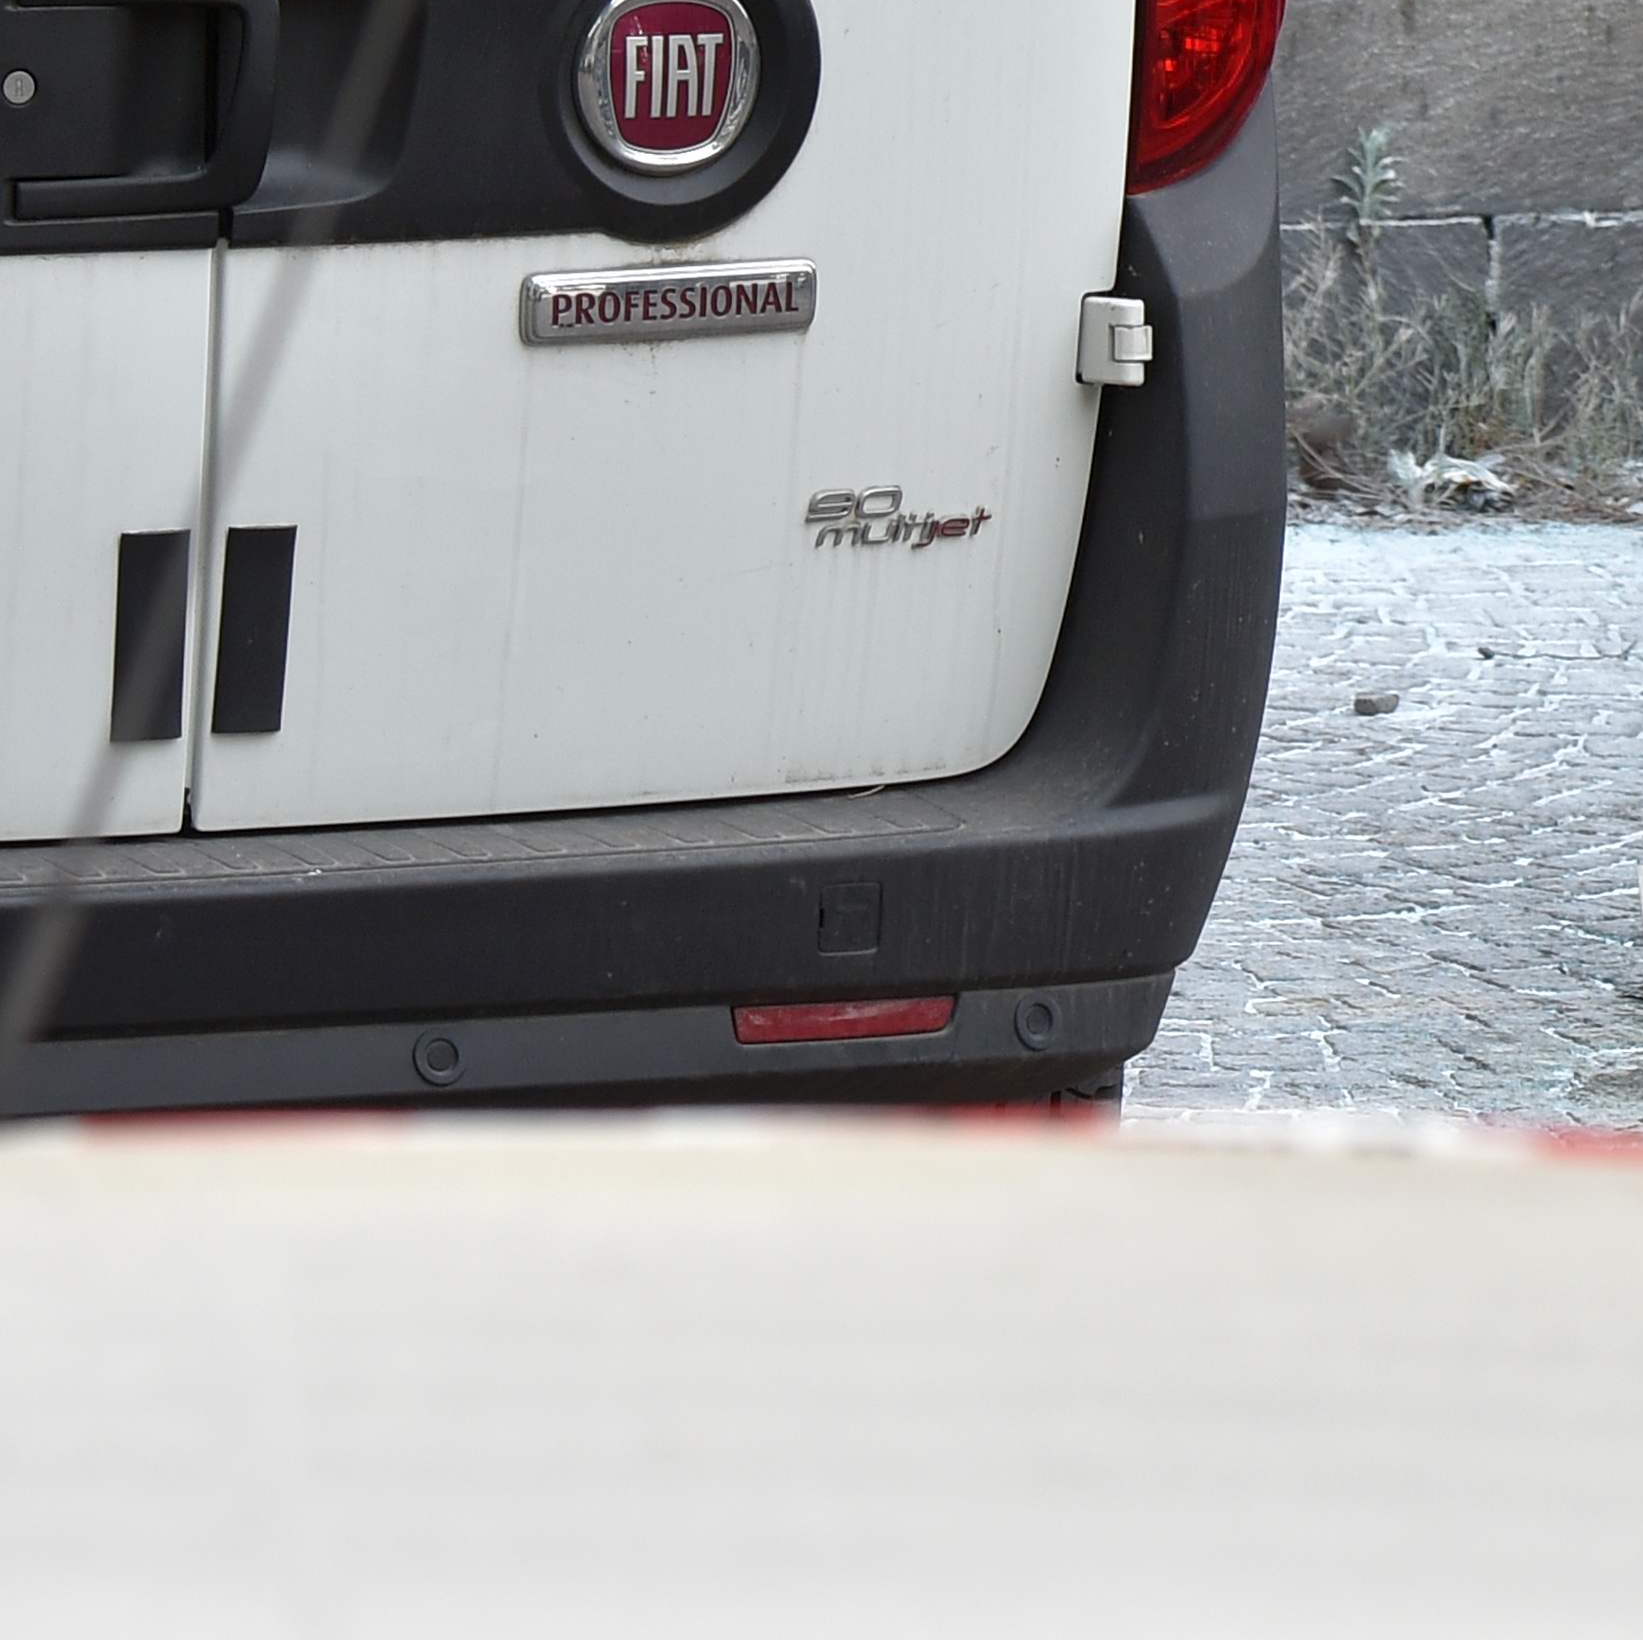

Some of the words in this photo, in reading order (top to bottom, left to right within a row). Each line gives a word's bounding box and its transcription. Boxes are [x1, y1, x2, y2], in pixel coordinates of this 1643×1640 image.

[624, 33, 724, 119] FIAT
[551, 281, 799, 327] PROFESSIONAL
[805, 485, 903, 523] 90
[815, 505, 992, 549] multijet
